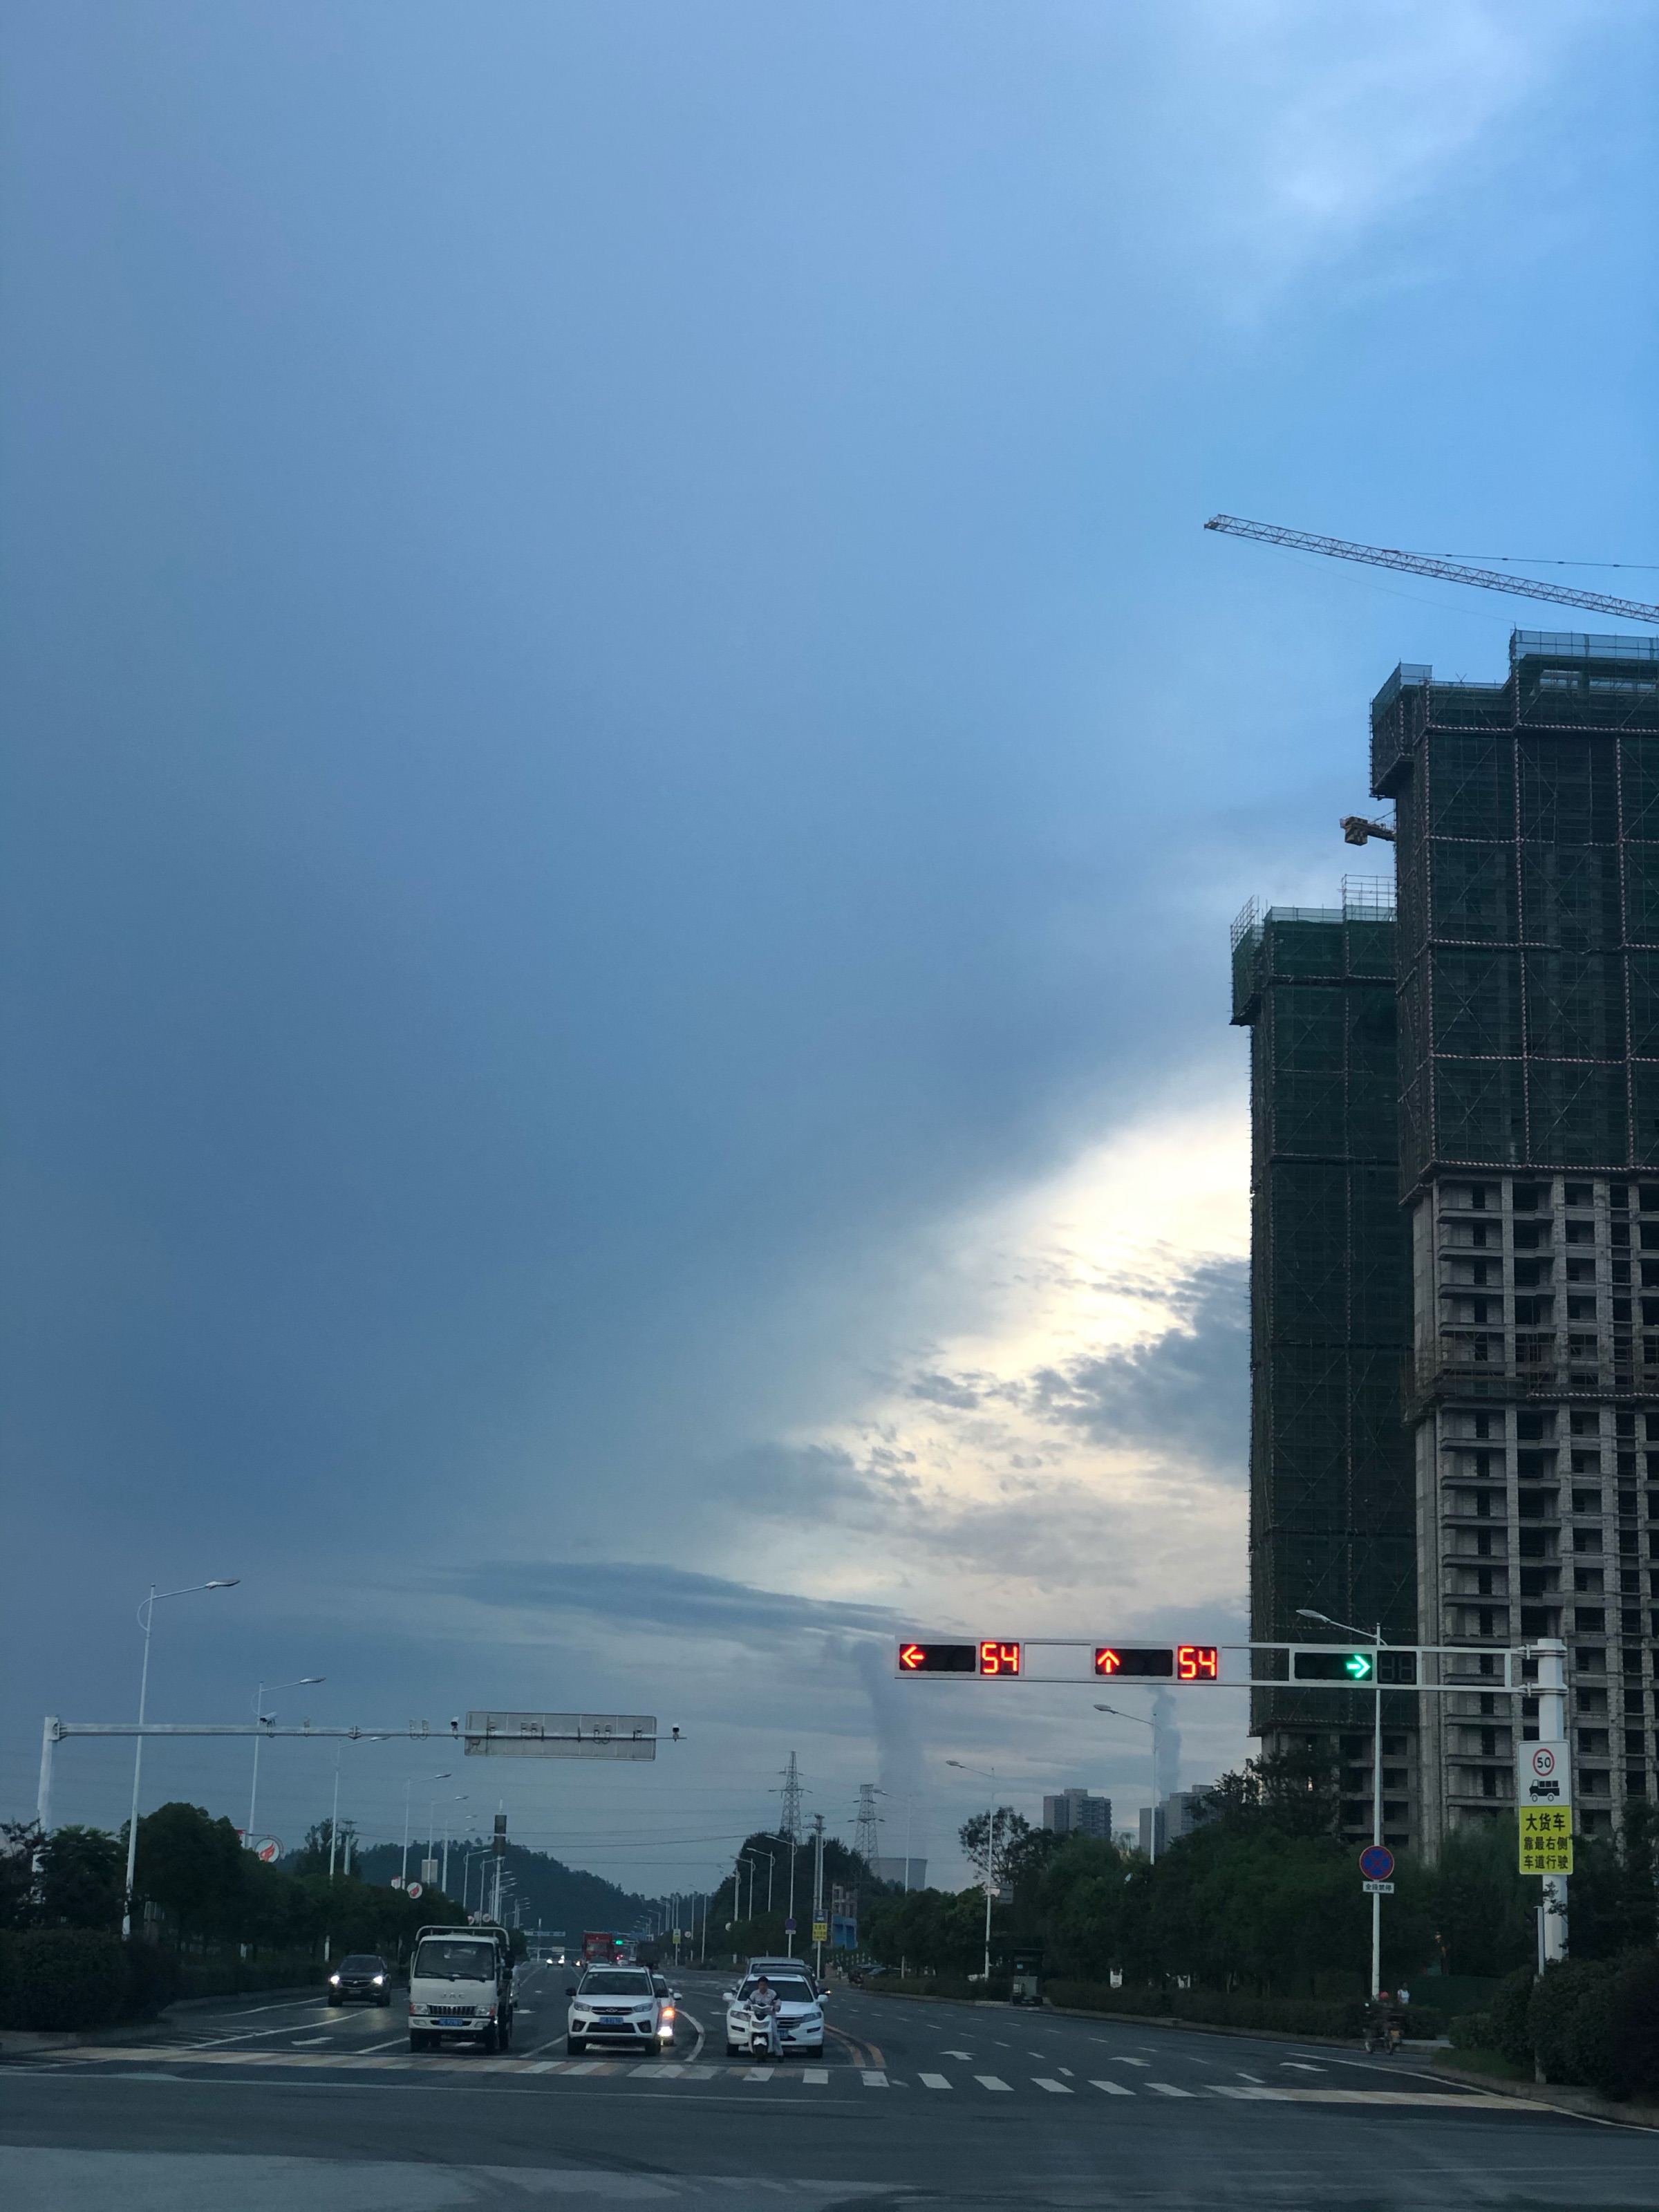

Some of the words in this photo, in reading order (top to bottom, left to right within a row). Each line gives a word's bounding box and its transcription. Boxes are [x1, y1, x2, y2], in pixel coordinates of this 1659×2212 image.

[982, 1643, 1018, 1673] 54
[1179, 1647, 1216, 1678] 54
[1537, 1756, 1551, 1768] 50
[1526, 1812, 1566, 1832] 大货车
[1524, 1836, 1568, 1850] 靠最右侧
[1524, 1855, 1568, 1869] 车道行驶
[1365, 1883, 1392, 1892] 全段禁停
[440, 1991, 466, 2000] JAC
